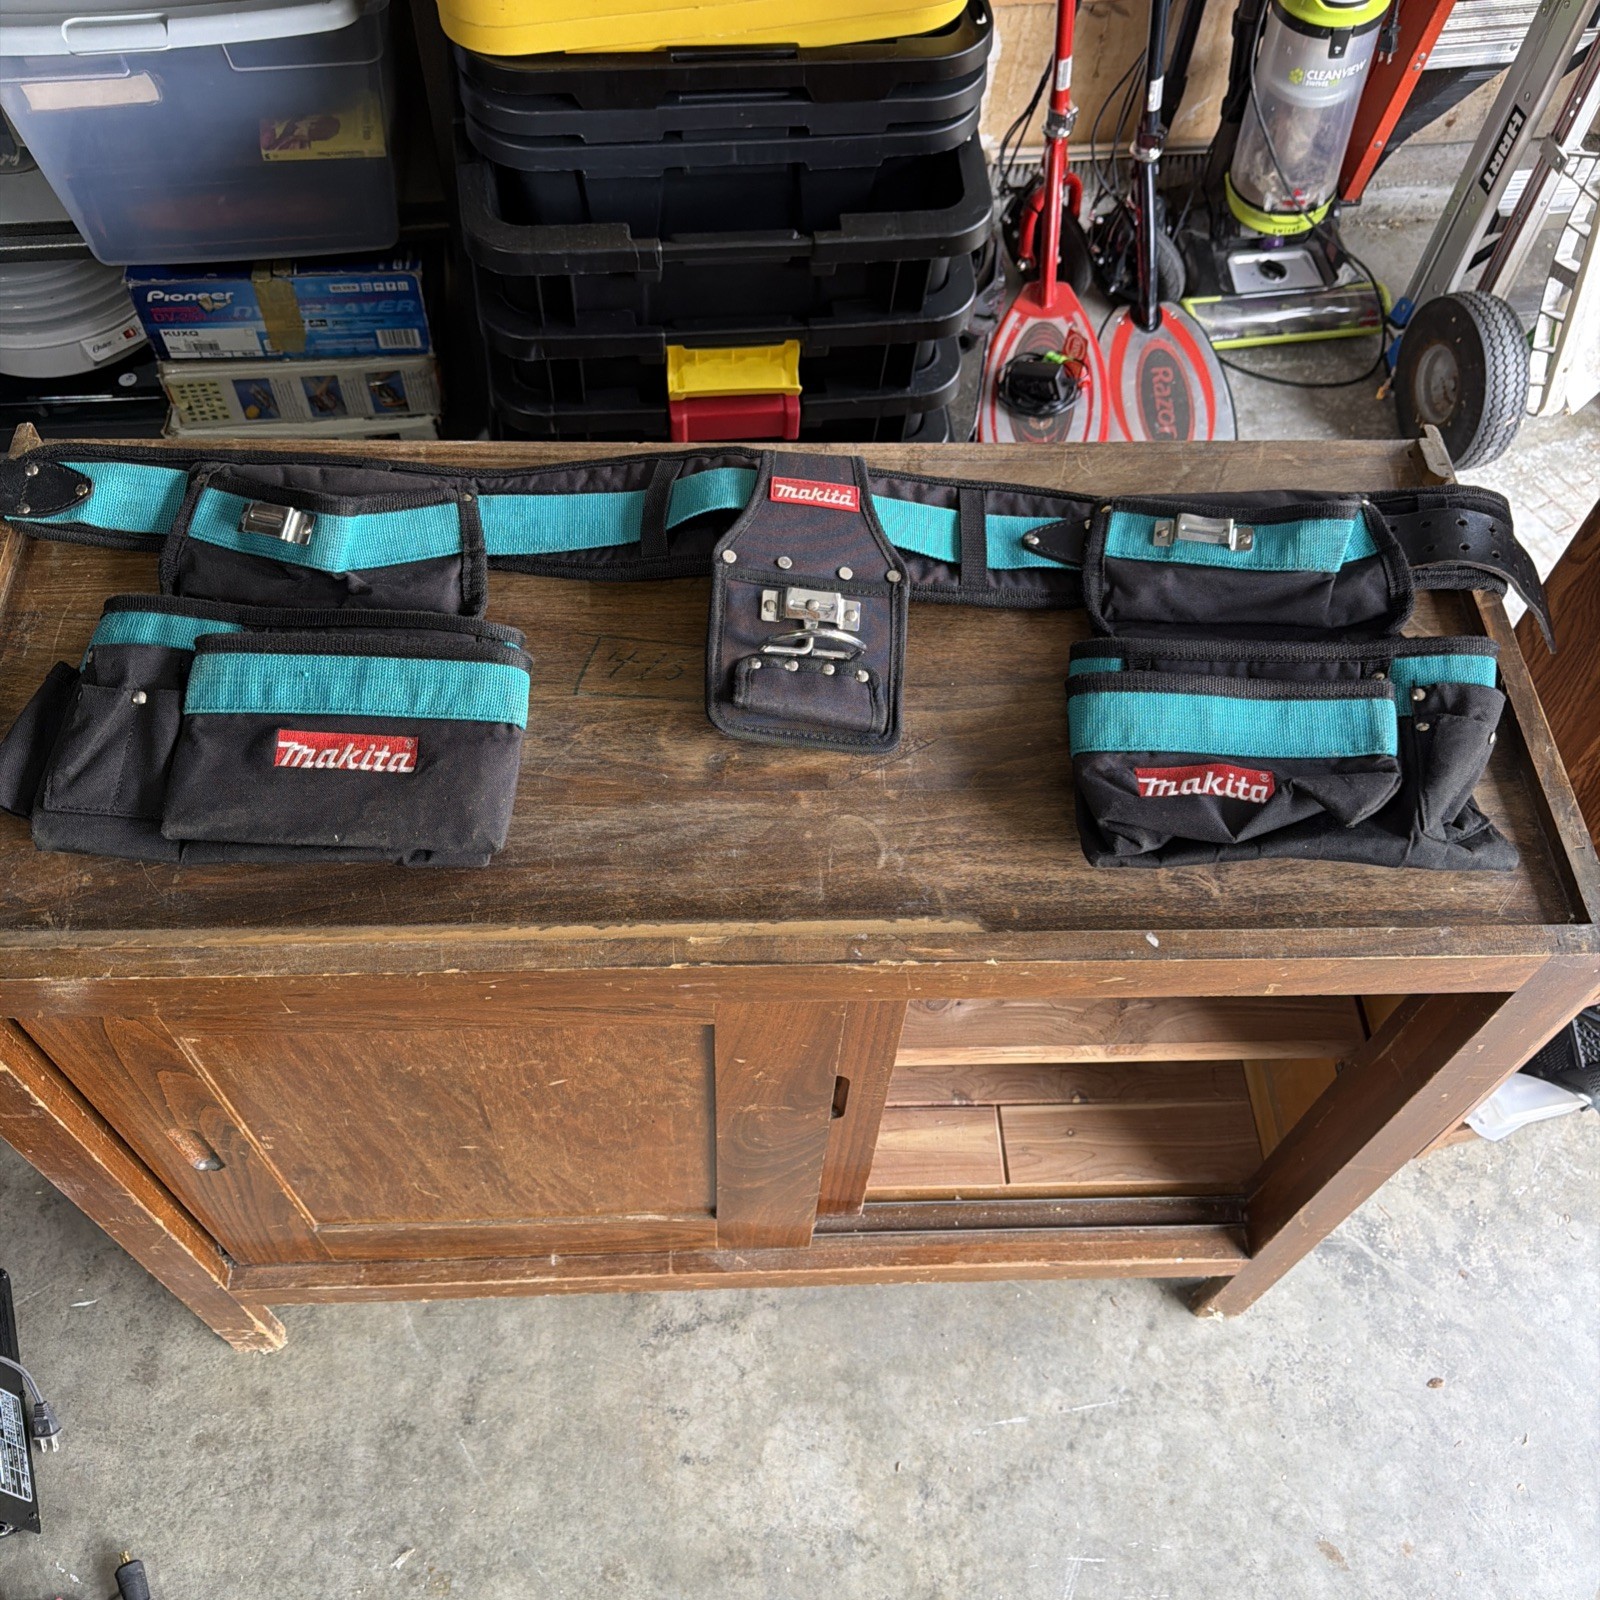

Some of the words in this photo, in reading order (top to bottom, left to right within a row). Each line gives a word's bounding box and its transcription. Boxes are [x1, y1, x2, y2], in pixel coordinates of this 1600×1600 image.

[1306, 59, 1367, 80] CLEANVIEW
[1484, 111, 1523, 190] HART
[147, 290, 234, 302] Pioneer
[322, 300, 416, 315] LAYER
[163, 330, 199, 338] KUXQ
[1150, 367, 1178, 440] Razor
